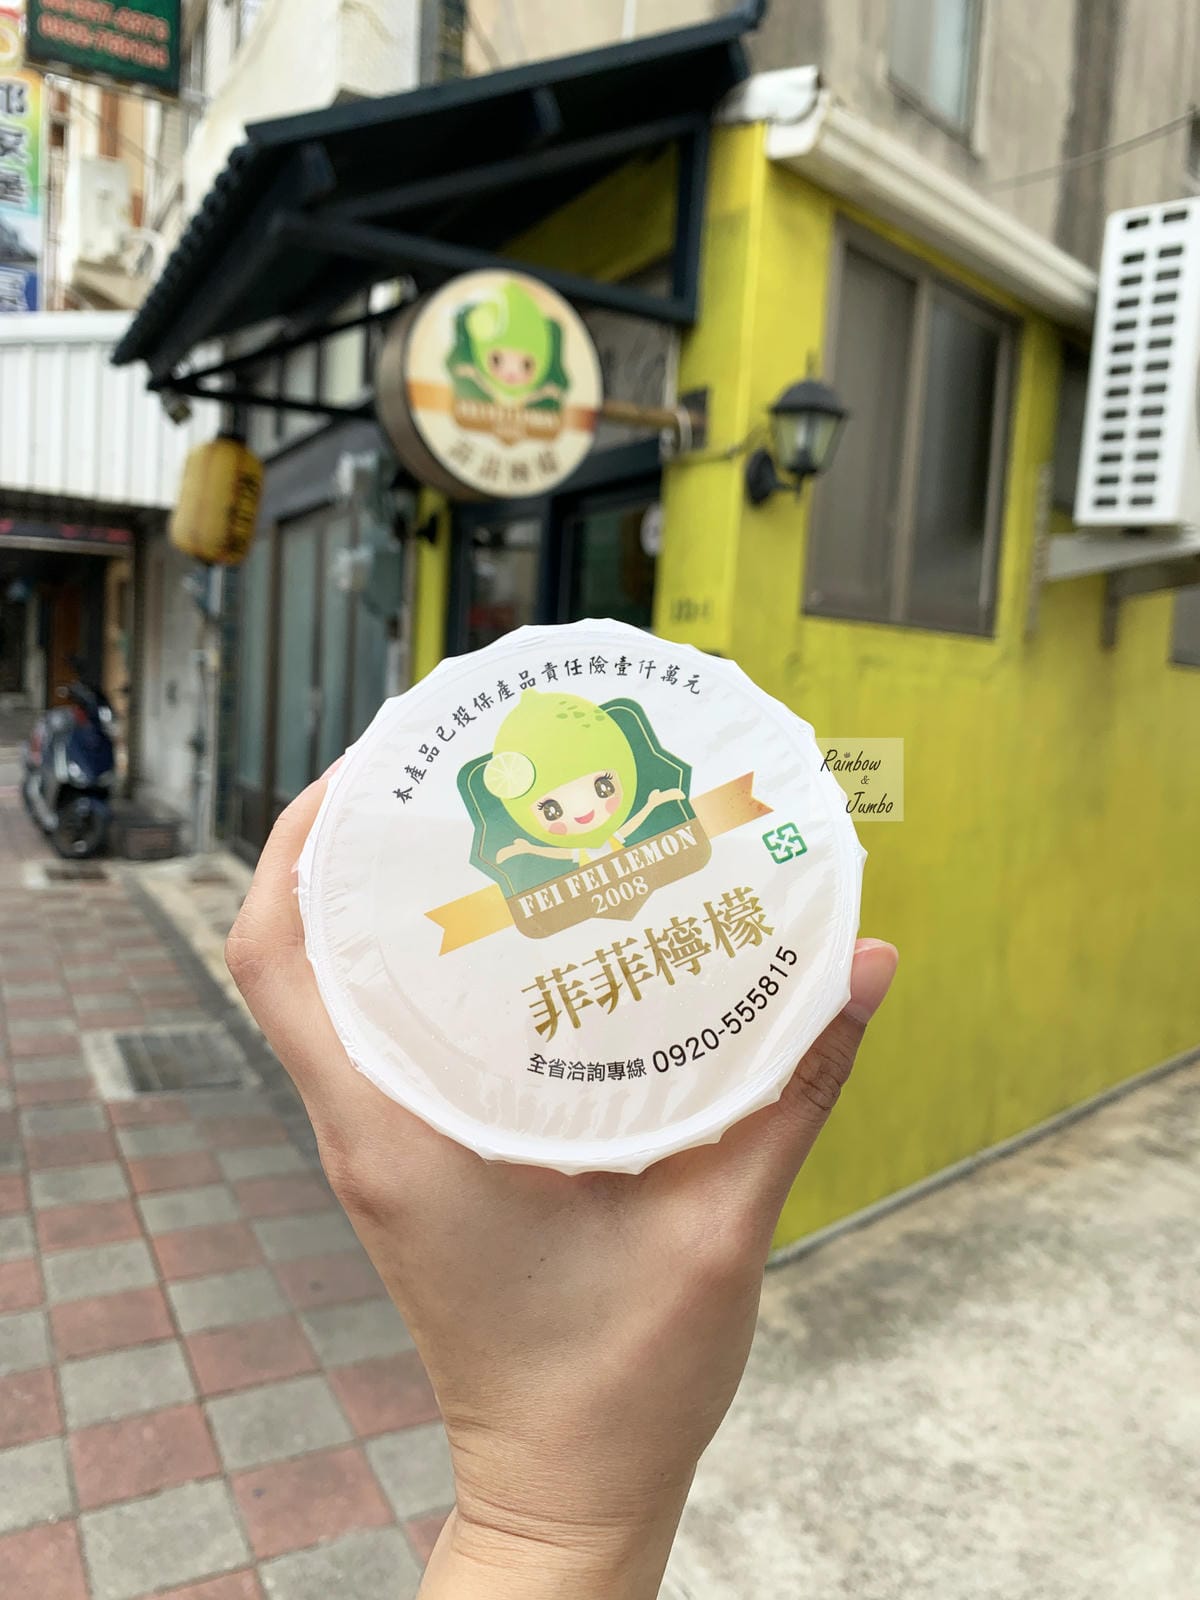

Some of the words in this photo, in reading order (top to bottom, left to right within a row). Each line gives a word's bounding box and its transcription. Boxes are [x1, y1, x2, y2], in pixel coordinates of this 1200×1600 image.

[518, 883, 564, 918] FEI
[564, 863, 610, 899] FEI
[610, 825, 698, 878] LEMON
[591, 875, 649, 914] 2008
[521, 886, 775, 1043] 菲菲檸檬
[527, 1053, 647, 1082] 全省洽詢專線
[652, 945, 798, 1073] 0920-555815
